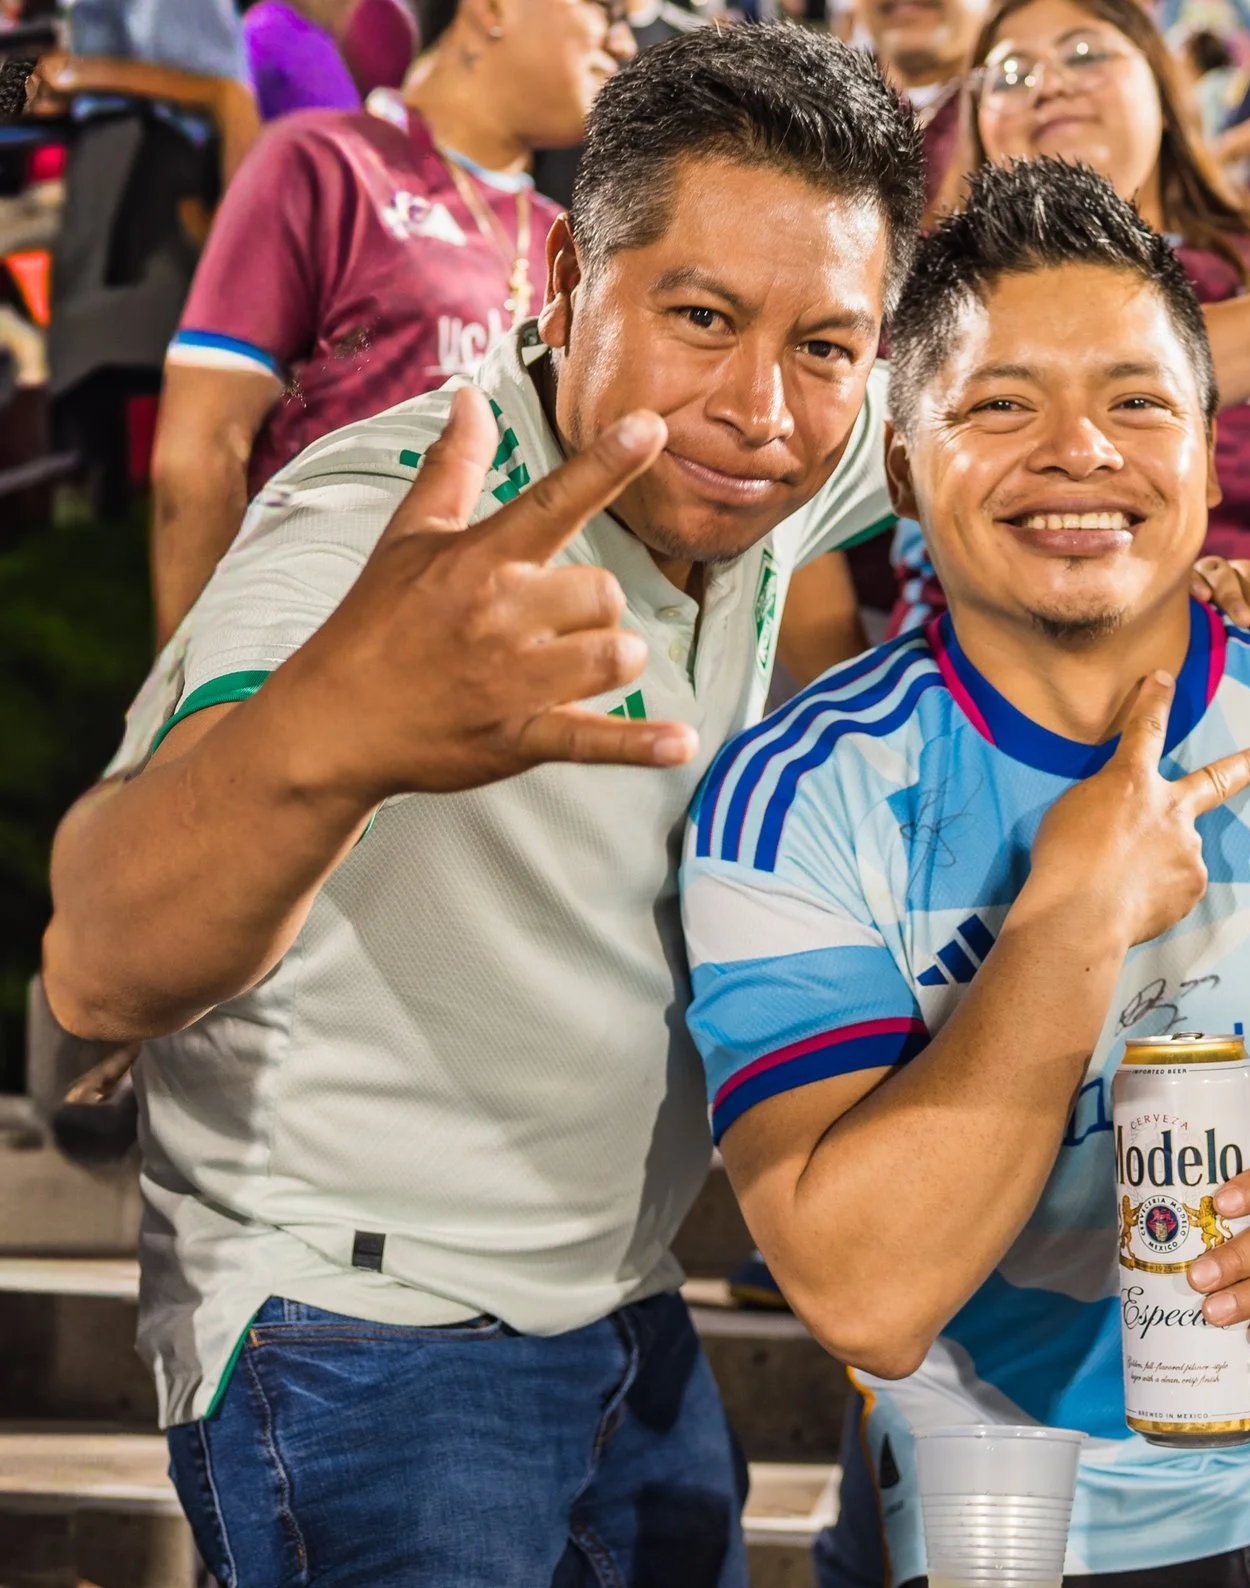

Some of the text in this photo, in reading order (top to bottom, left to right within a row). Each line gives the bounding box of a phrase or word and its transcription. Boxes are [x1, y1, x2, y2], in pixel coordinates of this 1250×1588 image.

[1130, 1113, 1189, 1131] CERVEZA
[1148, 1241, 1178, 1252] MEXICO
[1138, 1410, 1164, 1418] BREWED
